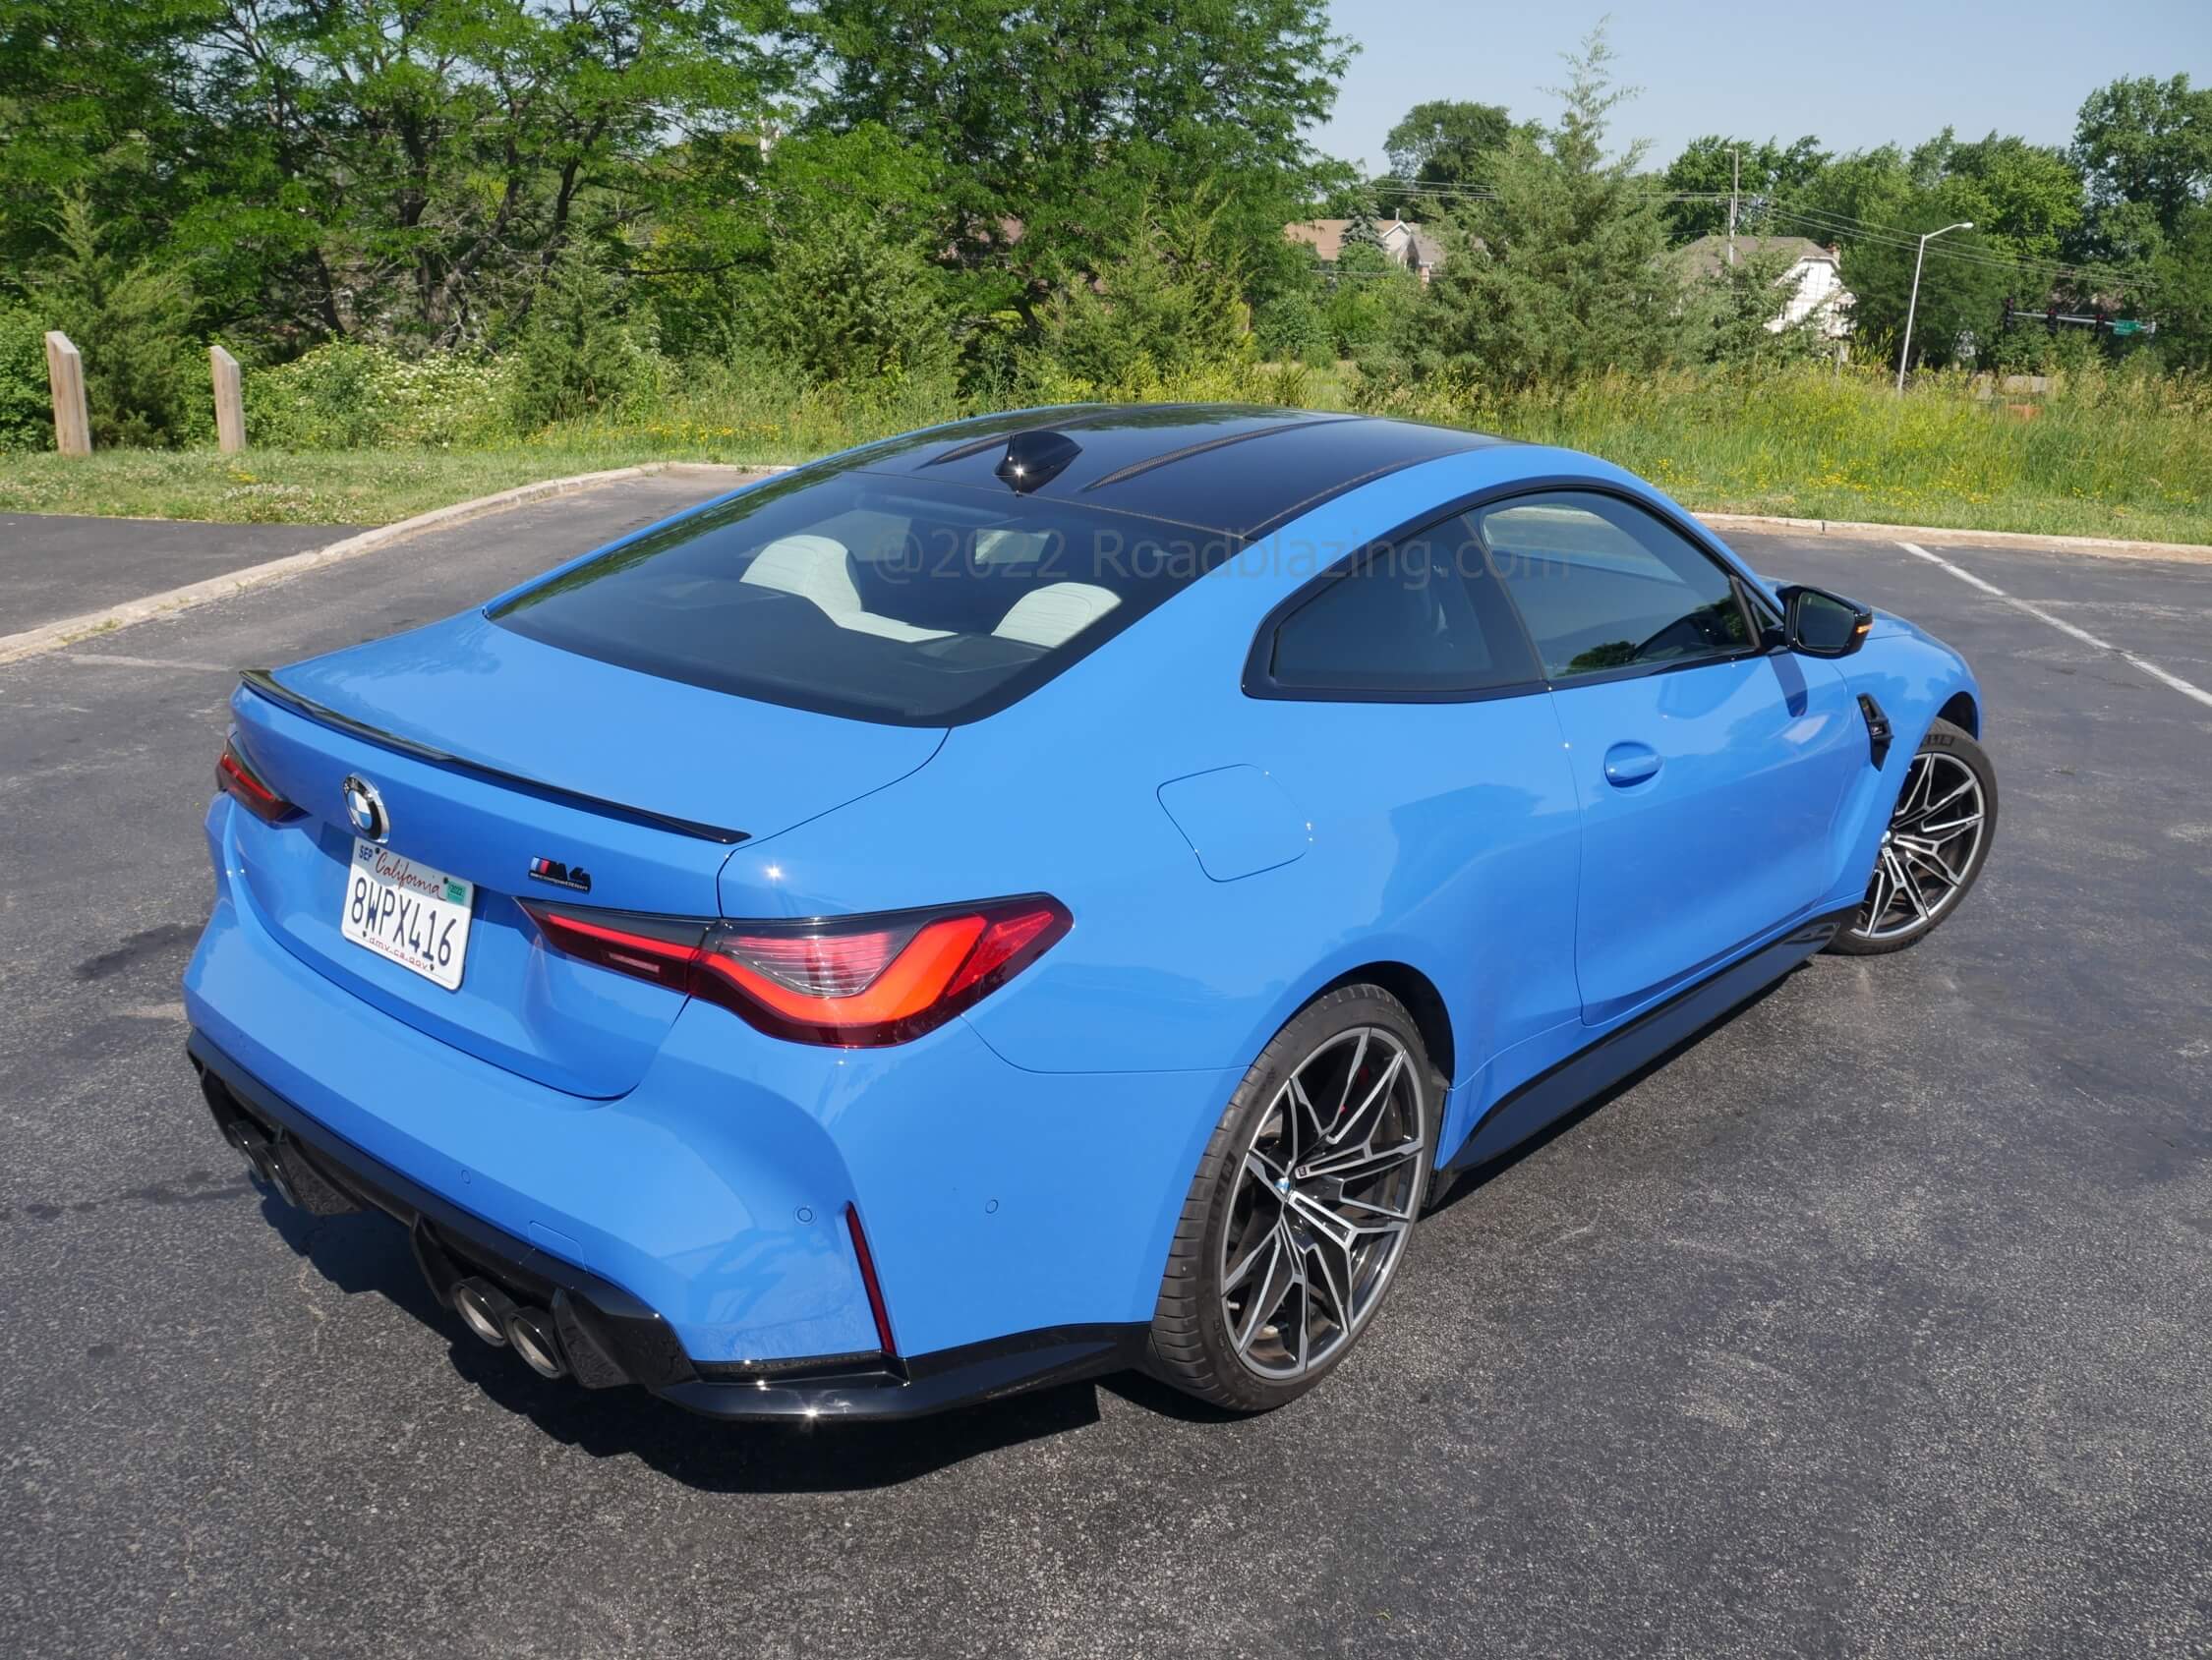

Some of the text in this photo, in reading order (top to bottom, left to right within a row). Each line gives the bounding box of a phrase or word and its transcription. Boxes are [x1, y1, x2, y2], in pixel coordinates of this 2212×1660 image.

[359, 844, 374, 861] SEP
[376, 851, 446, 901] California
[352, 877, 457, 967] 8WPX416
[369, 937, 429, 970] dmv.ca.gov
